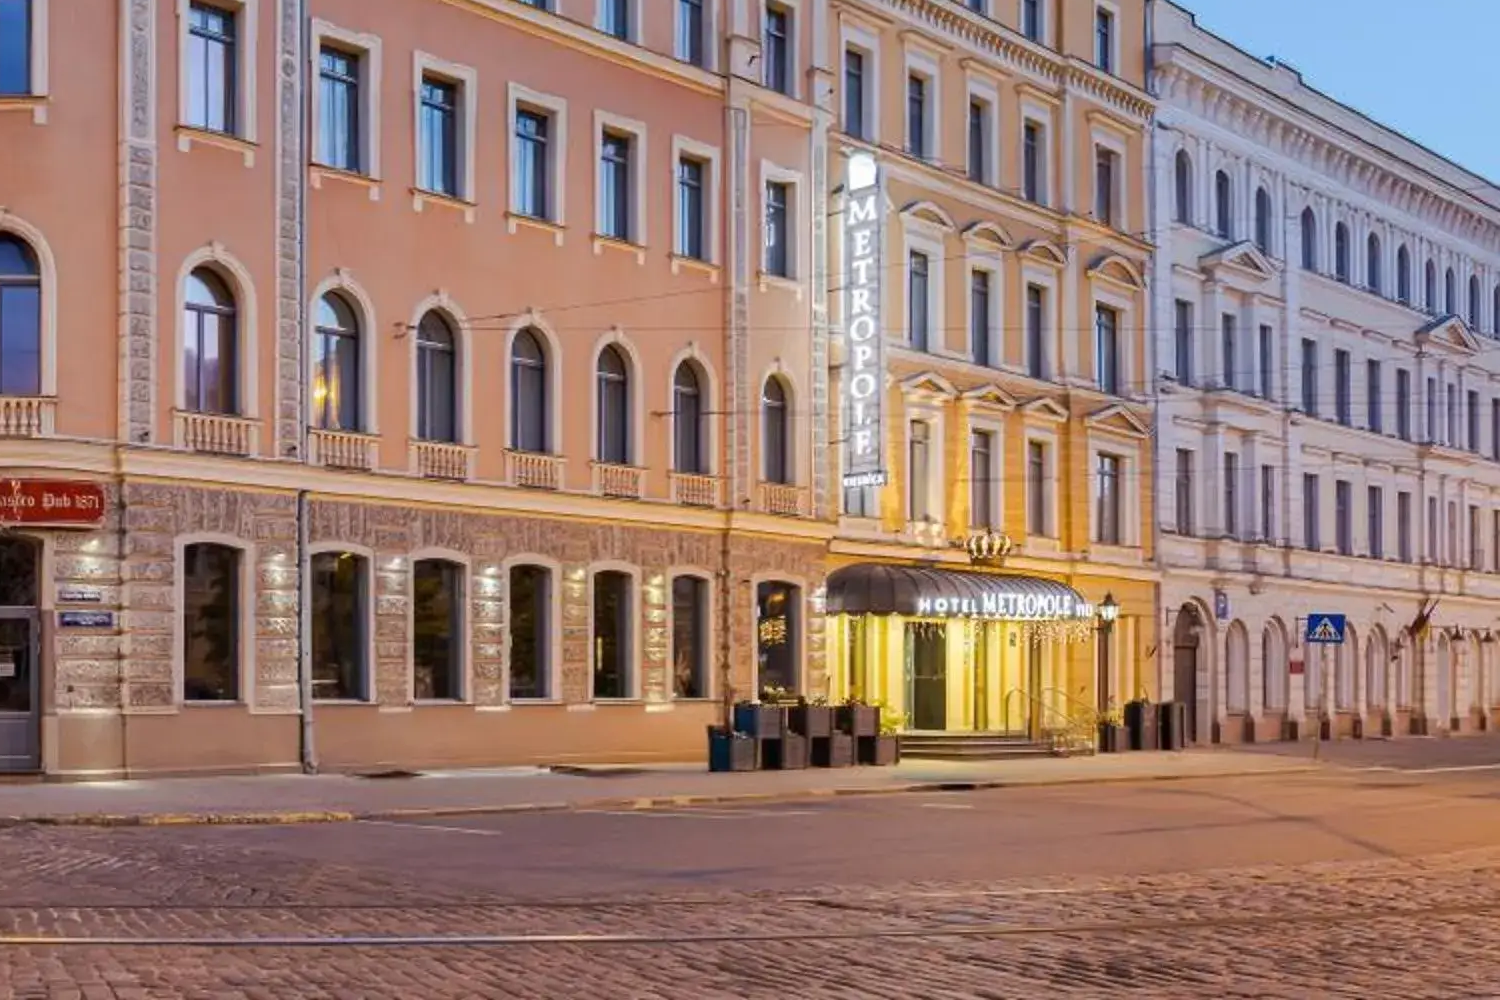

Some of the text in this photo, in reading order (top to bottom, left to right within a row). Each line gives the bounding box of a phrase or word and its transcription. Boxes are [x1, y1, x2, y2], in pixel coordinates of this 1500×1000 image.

[847, 195, 877, 455] METROPOLE
[919, 598, 978, 613] HOTEL
[982, 592, 1072, 615] METROPOLE
